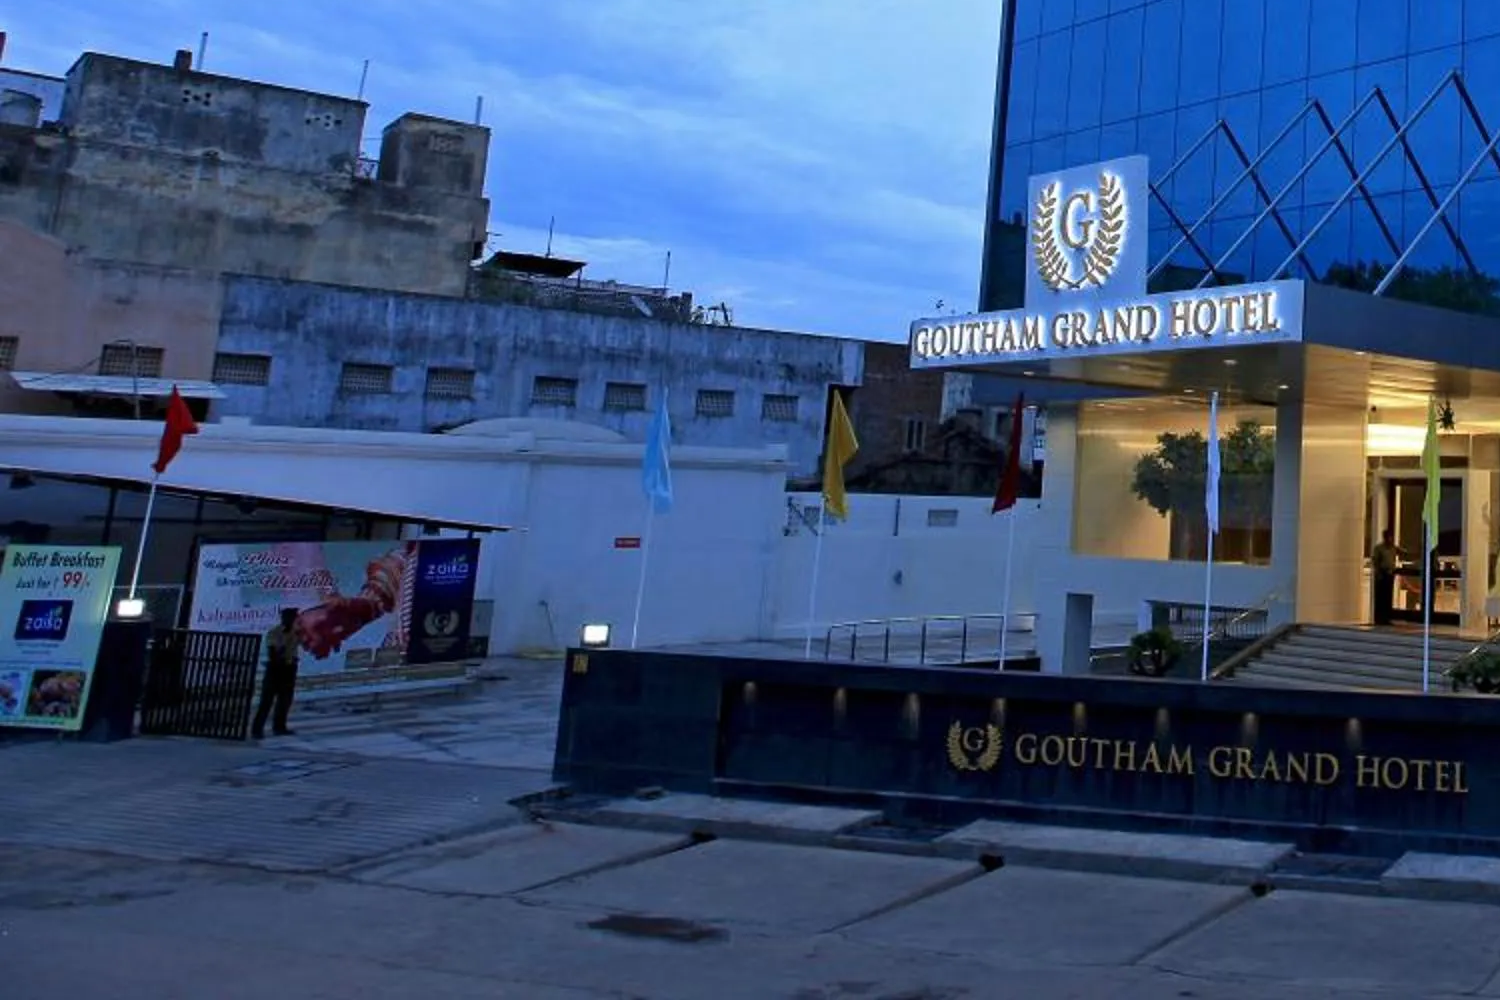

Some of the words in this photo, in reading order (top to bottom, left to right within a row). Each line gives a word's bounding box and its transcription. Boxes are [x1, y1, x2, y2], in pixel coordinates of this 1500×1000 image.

[1060, 192, 1095, 250] G
[914, 314, 1042, 359] GOUTHAM
[1051, 304, 1158, 348] GRAND
[1168, 291, 1279, 338] HOTEL
[13, 551, 48, 568] Buffet
[49, 551, 106, 569] Breakfast
[963, 728, 985, 751] G
[1014, 733, 1196, 776] GOUTHAM
[1208, 746, 1340, 786] GRAND
[1355, 754, 1470, 794] HOTEL
